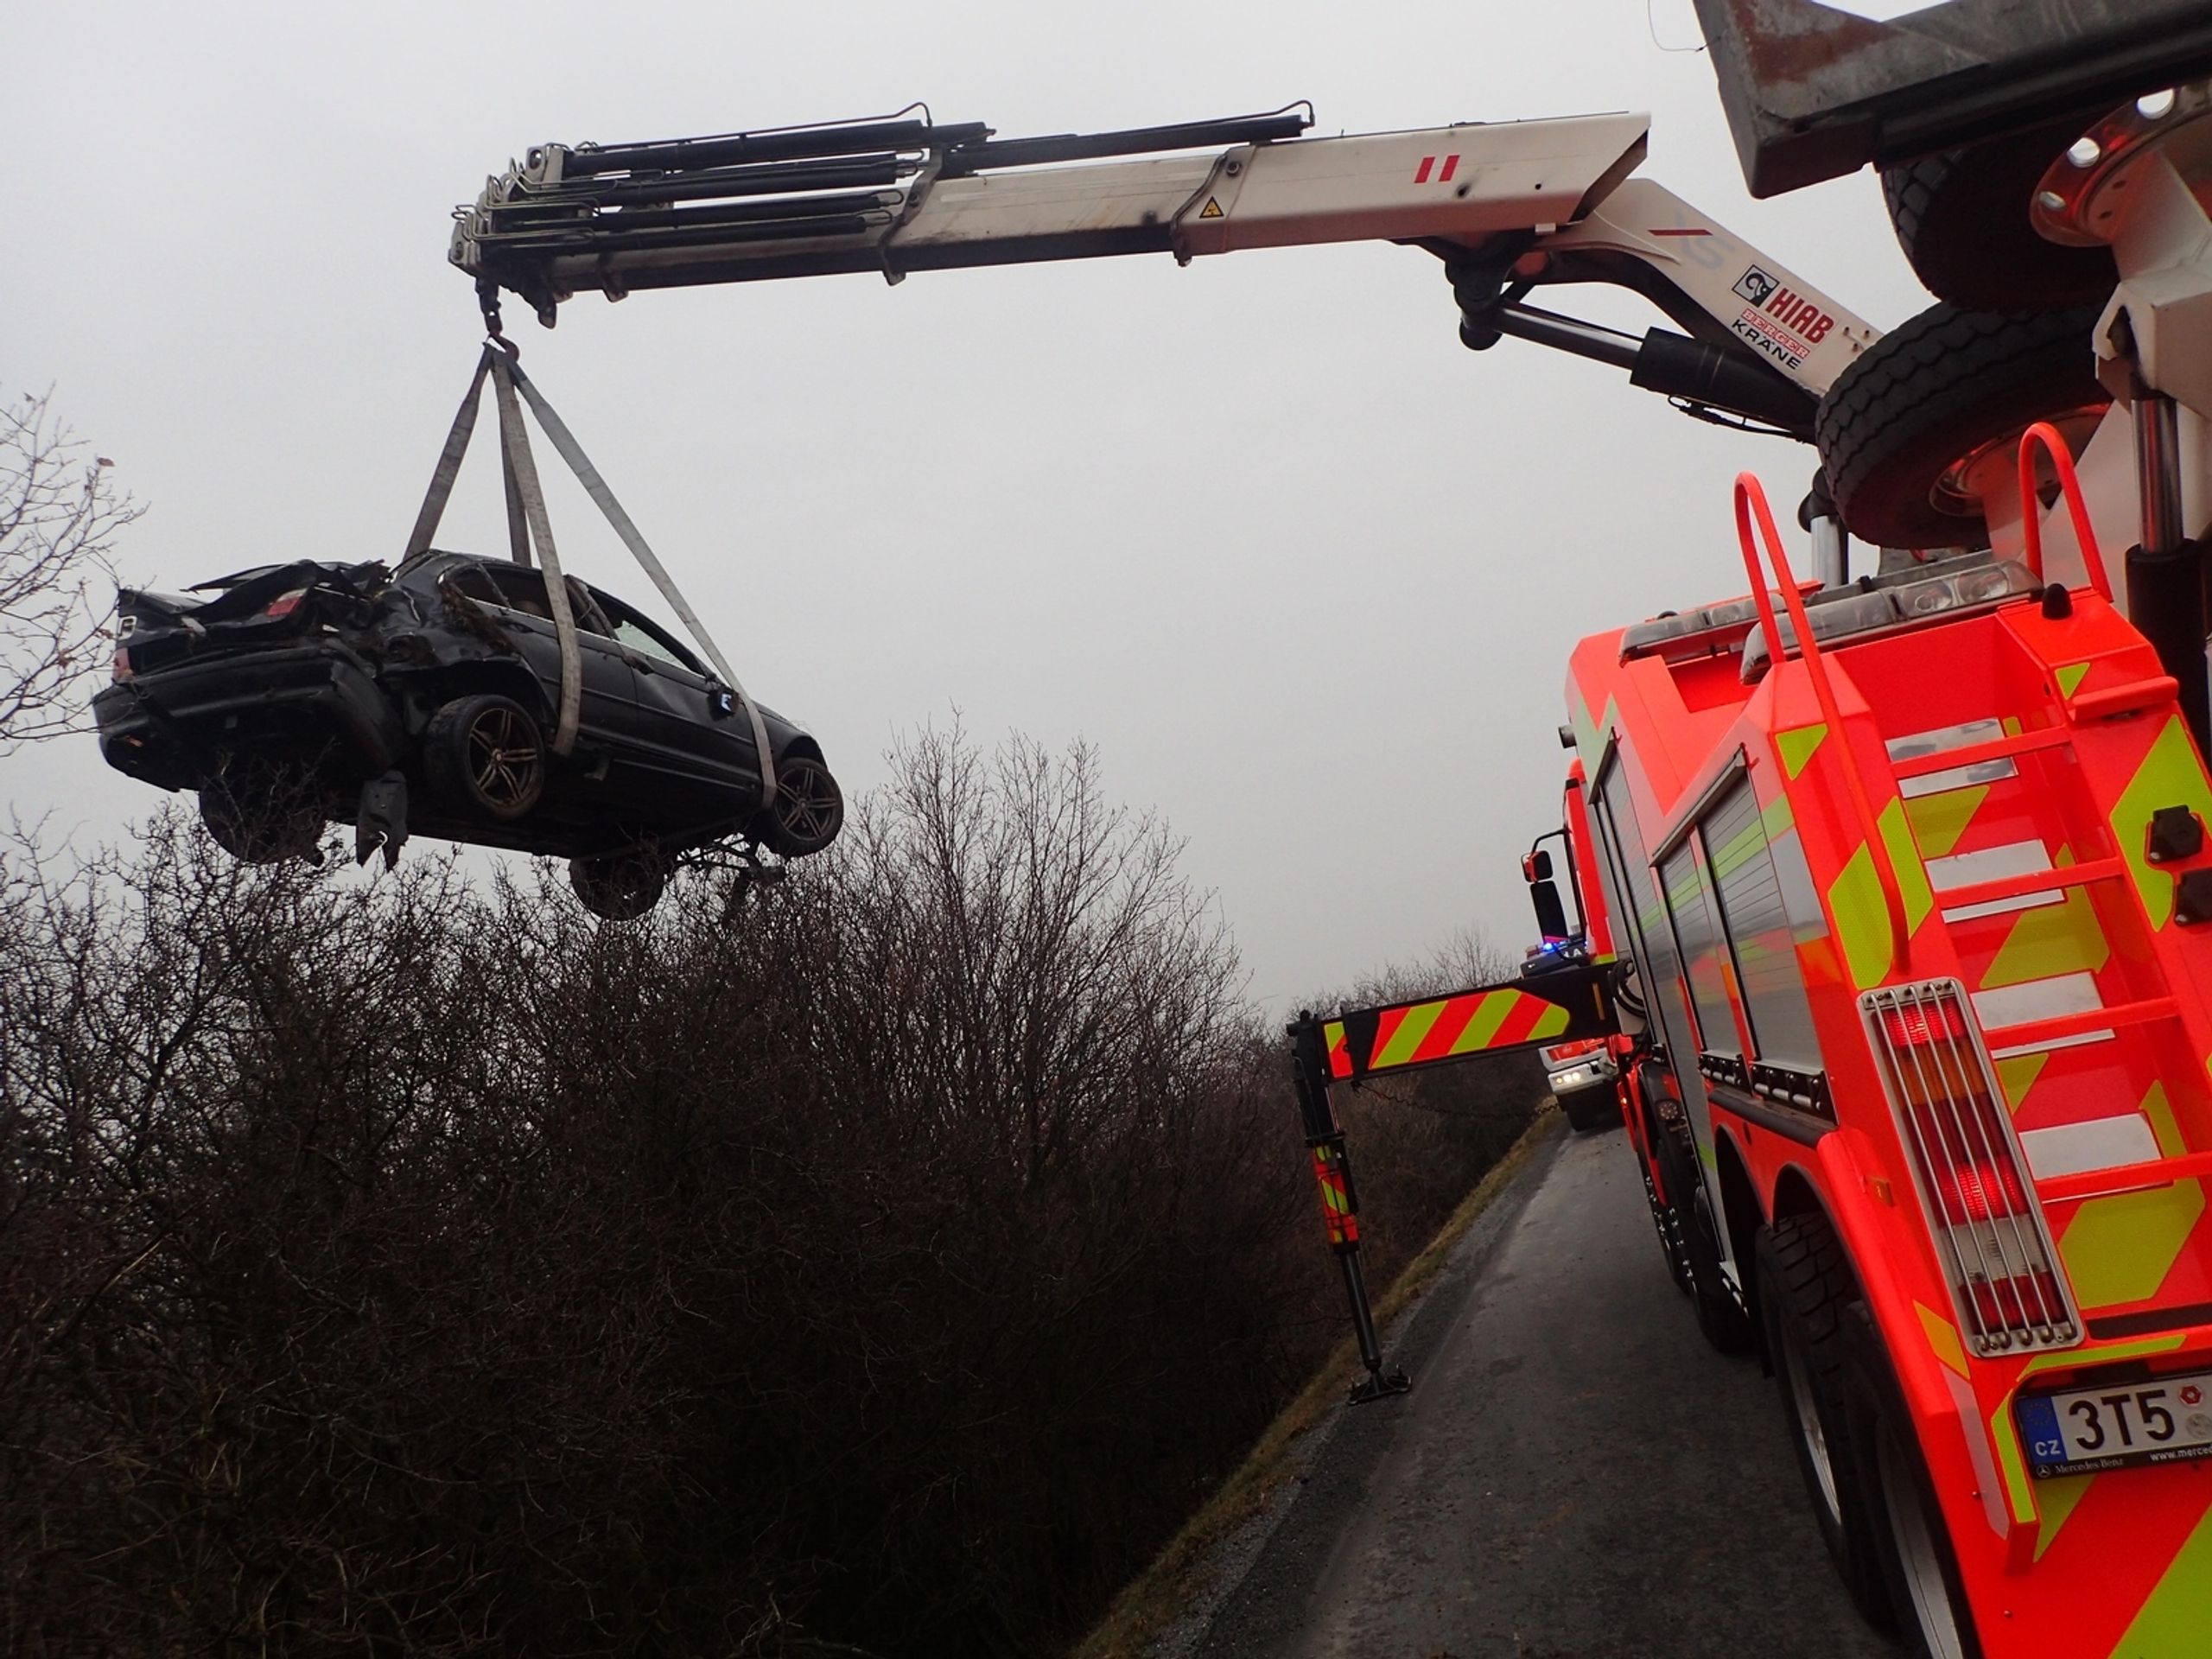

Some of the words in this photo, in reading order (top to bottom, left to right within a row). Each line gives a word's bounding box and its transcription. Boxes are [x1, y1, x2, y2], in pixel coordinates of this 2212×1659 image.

[1740, 308, 1810, 359] BERGER
[1765, 288, 1834, 344] HIAB
[2069, 1389, 2176, 1450] 3T5
[2035, 1440, 2061, 1456] CZ
